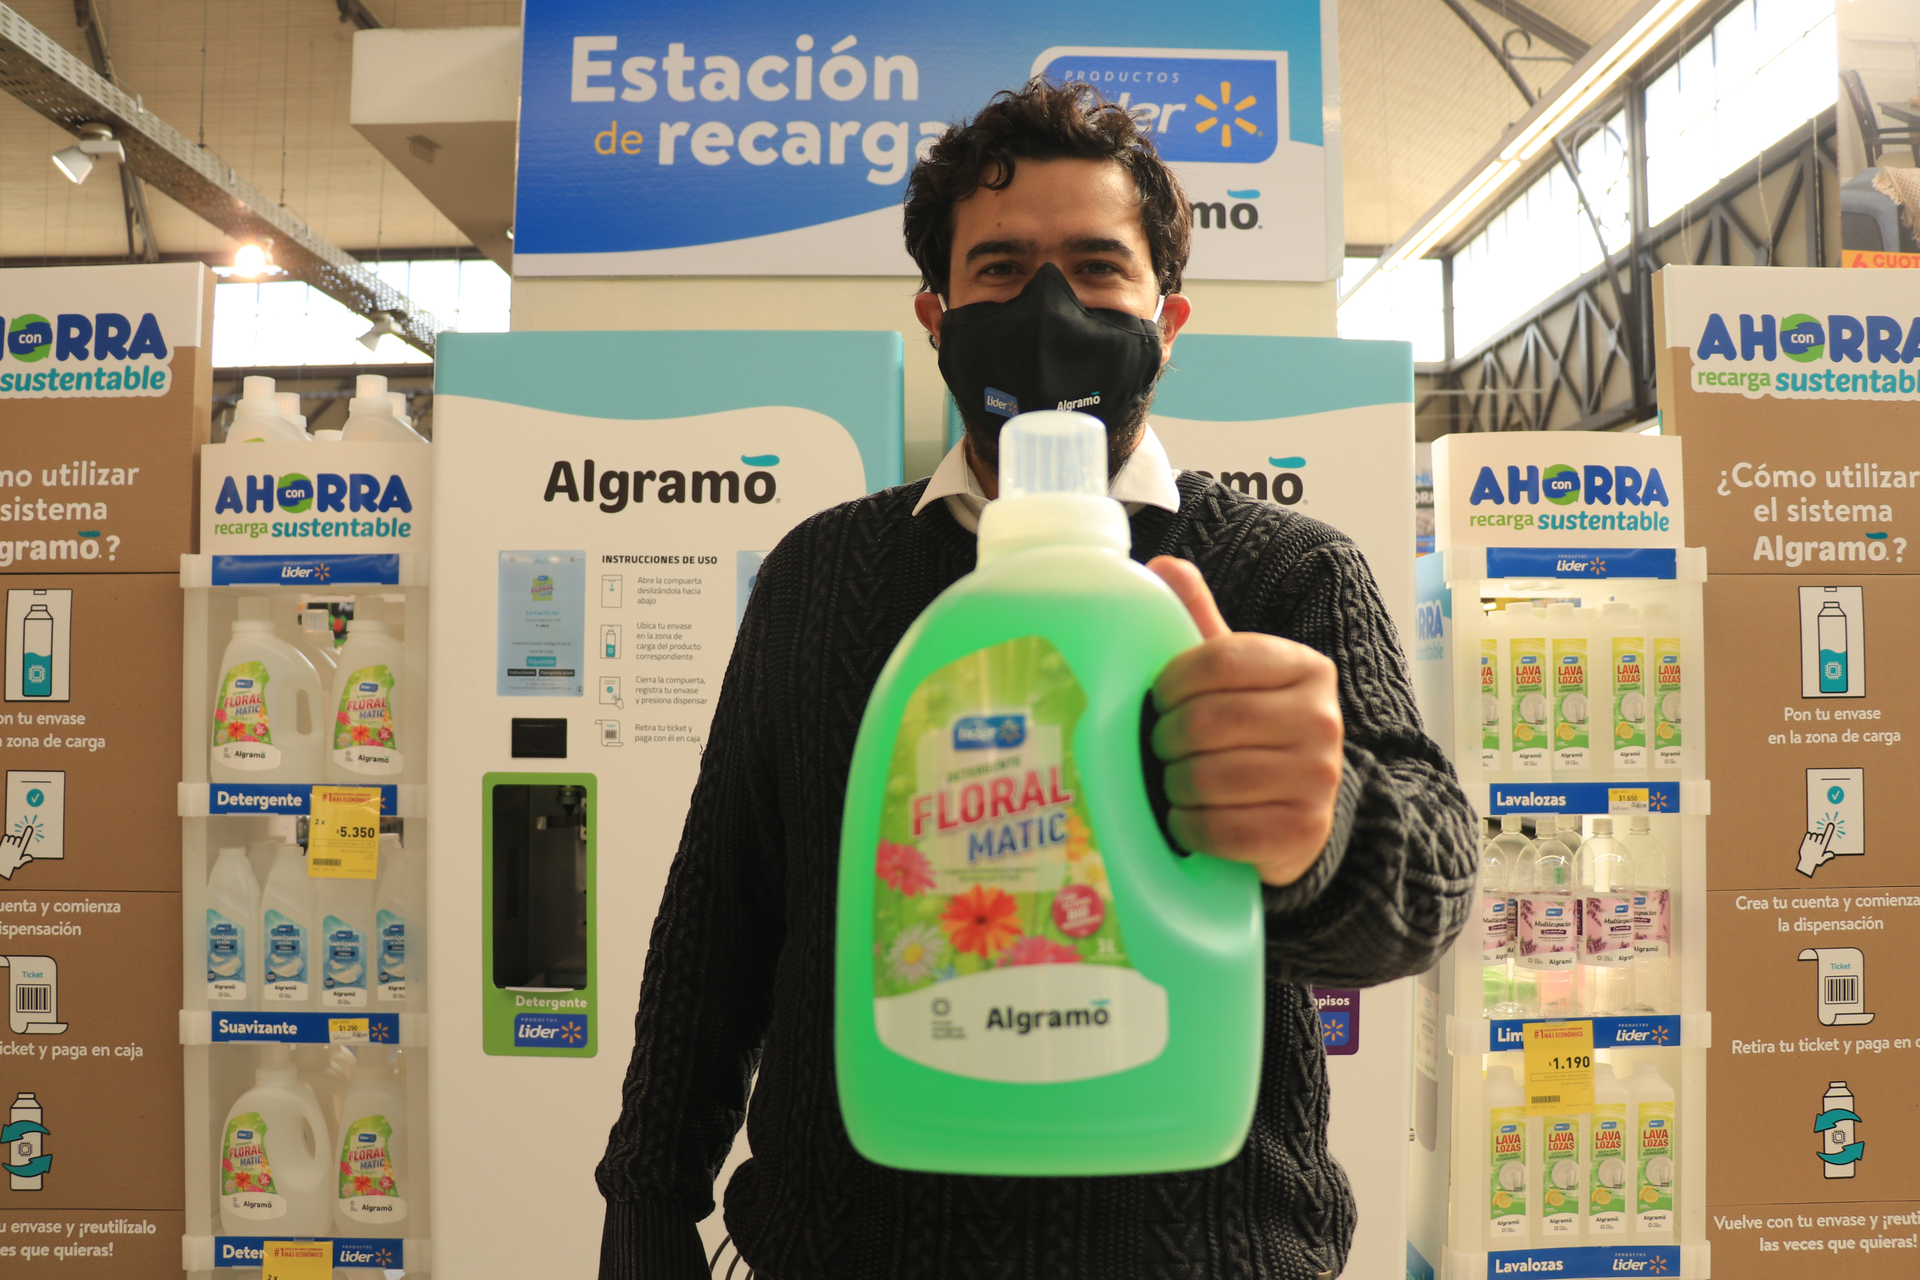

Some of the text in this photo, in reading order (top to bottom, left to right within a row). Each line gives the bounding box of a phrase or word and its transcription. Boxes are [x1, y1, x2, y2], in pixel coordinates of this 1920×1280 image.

[570, 35, 919, 104] Estación
[1064, 70, 1180, 84] PRODUCTOS
[594, 119, 643, 156] de
[0, 313, 168, 363] ORRA
[18, 332, 42, 345] con
[1790, 331, 1815, 345] con
[0, 365, 166, 392] sustentable
[1697, 370, 1771, 392] recarga
[41, 460, 140, 486] utilizar
[1716, 461, 1920, 497] ¿Cómo utilizar
[1469, 463, 1669, 508] AHORRA
[1551, 478, 1572, 490] con
[215, 472, 413, 515] AHORRA
[284, 488, 306, 499] con
[0, 496, 108, 521] sistema
[1753, 496, 1894, 522] el sistema
[214, 516, 412, 539] recarga sustentable
[1469, 510, 1670, 532] recarga sustentable
[601, 554, 718, 565] INSTRUCCIONES DE USO
[637, 576, 702, 586] Abre la compuerta
[637, 586, 701, 595] deslizándola hacia
[636, 597, 657, 606] abajo
[636, 621, 656, 630] Ubica
[657, 622, 666, 630] tu
[646, 632, 654, 640] la
[673, 632, 683, 640] de
[636, 642, 702, 652] carga del producto
[635, 652, 694, 662] correspondiente
[1516, 665, 1542, 676] LAVA
[1558, 665, 1584, 676] LAVA
[1617, 664, 1641, 675] LAVA
[635, 675, 706, 685] Cierra compuerta,
[1516, 676, 1542, 685] LOZAS
[1558, 676, 1584, 685] LOZAS
[1617, 675, 1641, 683] LOZAS
[635, 686, 699, 696] registra envase
[224, 693, 263, 709] FLORAL
[346, 697, 388, 712] FLORAL
[640, 696, 708, 706] presiona dispensar
[17, 712, 86, 726] tu envase
[1784, 706, 1882, 722] Pon tu envase
[634, 723, 687, 732] Retira ticket
[6, 736, 40, 748] zona
[43, 733, 62, 748] de
[65, 736, 106, 752] carga
[634, 735, 653, 744] paga
[685, 734, 701, 744] caja
[1767, 728, 1902, 746] en la zona de carga
[217, 790, 303, 811] Detergente
[912, 765, 1072, 837] FLORAL
[1496, 791, 1567, 809] Lavalozas
[968, 812, 1066, 863] MATIC
[40, 898, 121, 917] y comienza
[1735, 892, 1920, 912] Crea tu cuenta y comienza
[1777, 916, 1884, 936] la dispensación
[1829, 962, 1852, 971] Ticket
[22, 971, 44, 980] Ticket
[515, 995, 588, 1011] Detergente
[986, 999, 1110, 1035] Algramo
[218, 1018, 298, 1036] Suavizante
[38, 1042, 144, 1062] y paga en caja
[1731, 1038, 1776, 1054] Retira
[1779, 1039, 1795, 1053] tu
[1798, 1037, 1840, 1053] ticket
[1843, 1039, 1852, 1055] y
[1855, 1037, 1891, 1055] paga
[1893, 1037, 1912, 1049] en
[1495, 1133, 1522, 1144] LAVA
[1548, 1132, 1575, 1142] LAVA
[1595, 1130, 1622, 1140] LAVA
[1643, 1128, 1669, 1139] LAVA
[1495, 1144, 1522, 1154] LOZAS
[1548, 1142, 1575, 1151] LOZAS
[1595, 1140, 1622, 1149] LOZAS
[1643, 1139, 1669, 1148] LOZAS
[228, 1144, 264, 1159] FLORAL
[348, 1147, 387, 1163] FLORAL
[10, 1218, 157, 1238] envase y ¡reutilízalo
[1713, 1214, 1763, 1231] Vuelve
[1766, 1216, 1794, 1229] con
[1796, 1215, 1813, 1228] tu
[1816, 1214, 1867, 1228] envase
[1869, 1215, 1878, 1231] y
[20, 1241, 115, 1262] que quieras!
[1759, 1233, 1918, 1255] las veces que quieras!
[1495, 1257, 1564, 1275] Lavalozas
